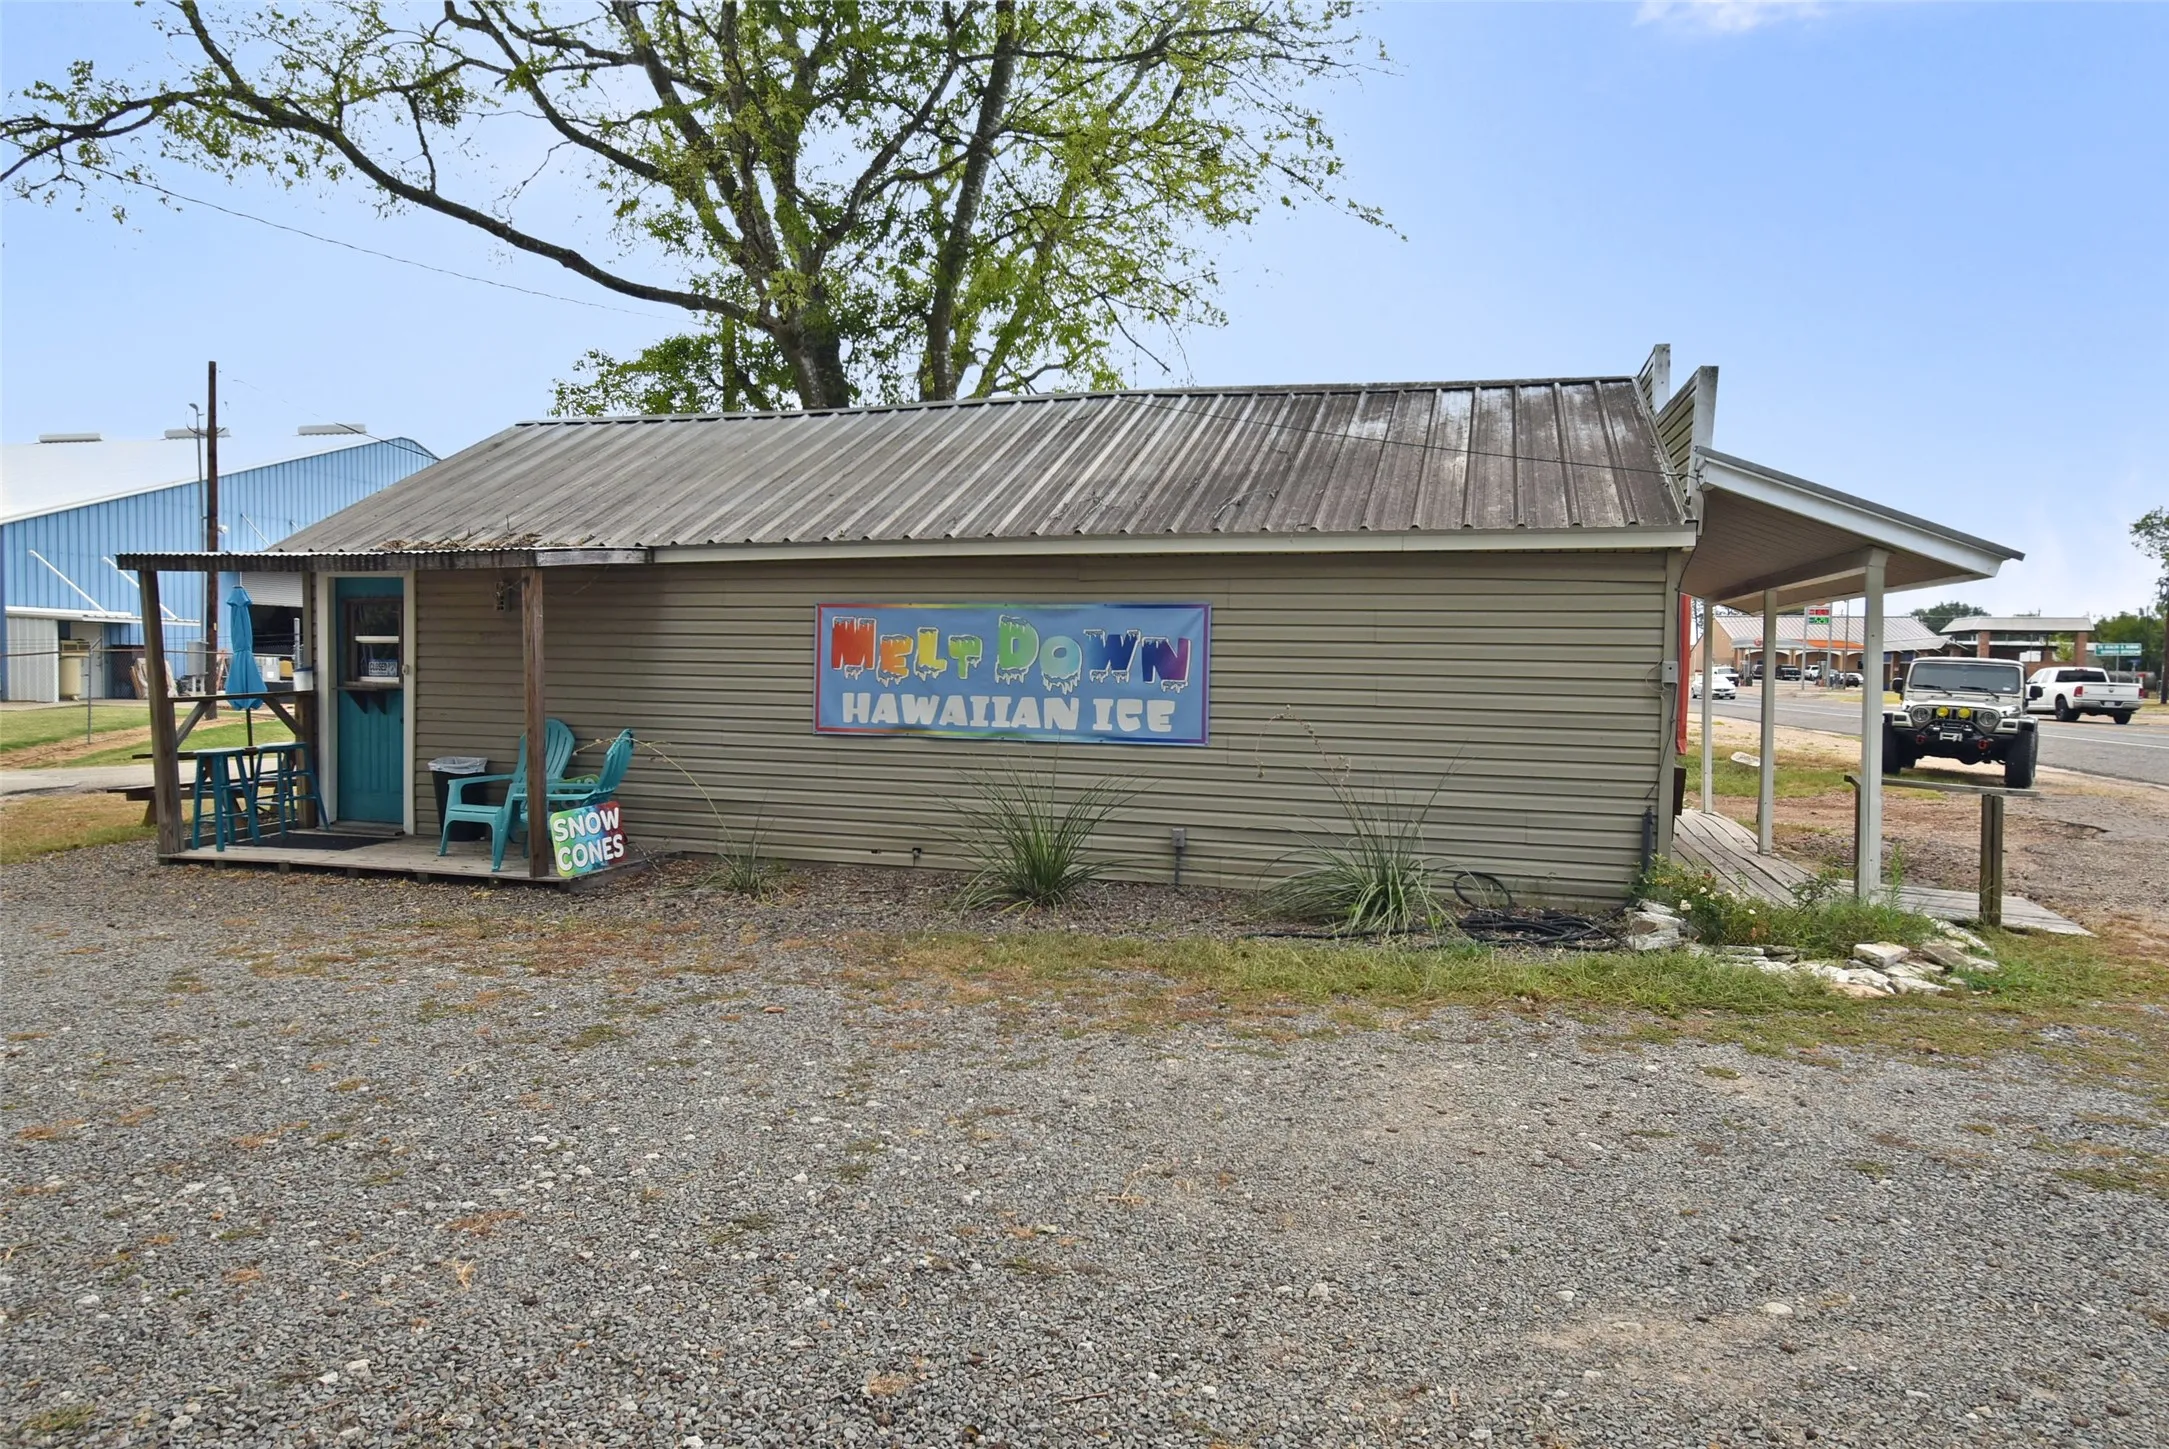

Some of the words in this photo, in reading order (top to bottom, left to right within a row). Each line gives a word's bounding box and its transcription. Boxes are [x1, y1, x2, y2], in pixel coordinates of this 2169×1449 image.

[842, 692, 1080, 731] HAWAIIAN
[1092, 698, 1176, 732] ICE
[553, 807, 620, 842] SNOW
[557, 833, 625, 871] CONES
